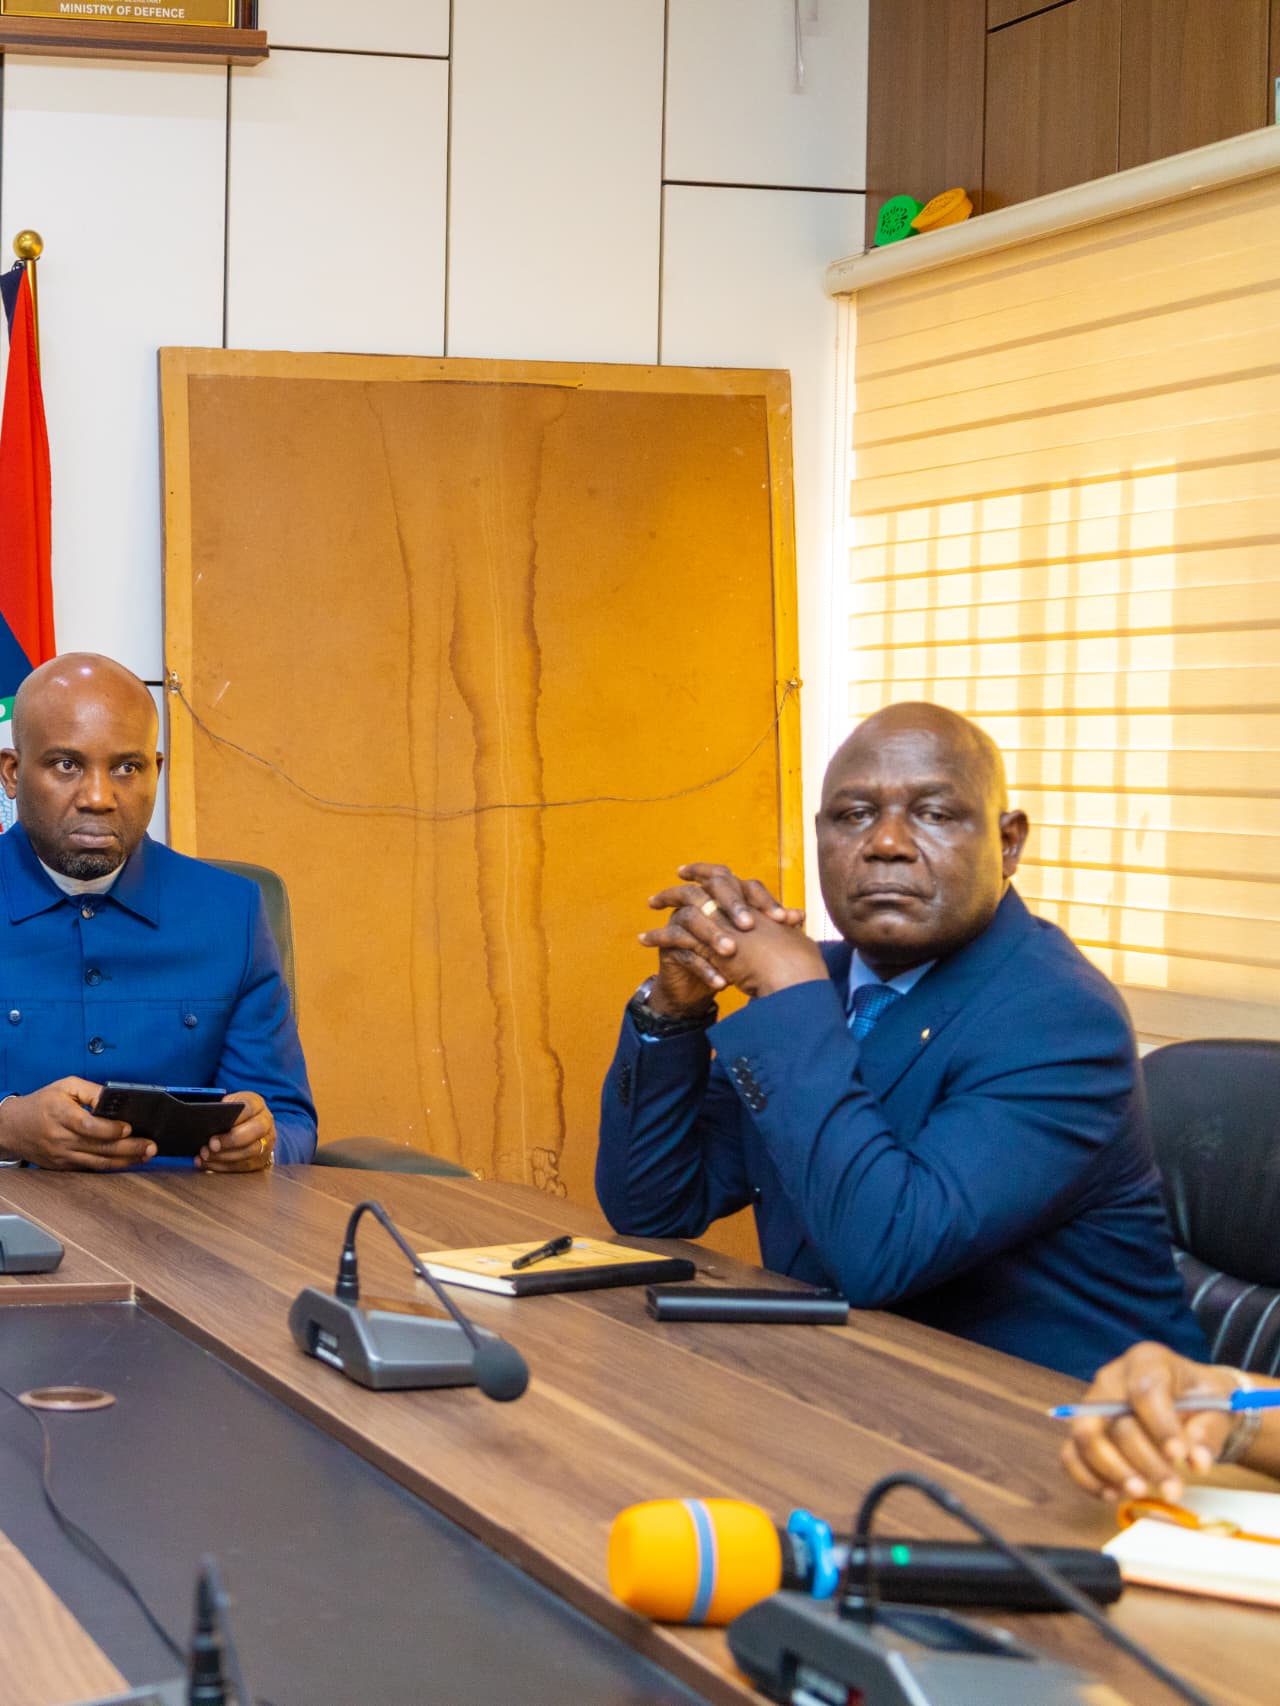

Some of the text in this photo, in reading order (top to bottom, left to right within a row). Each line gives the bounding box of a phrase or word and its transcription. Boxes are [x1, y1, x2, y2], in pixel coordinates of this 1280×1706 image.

[59, 3, 185, 19] MINISTRY OF DEFENCE
